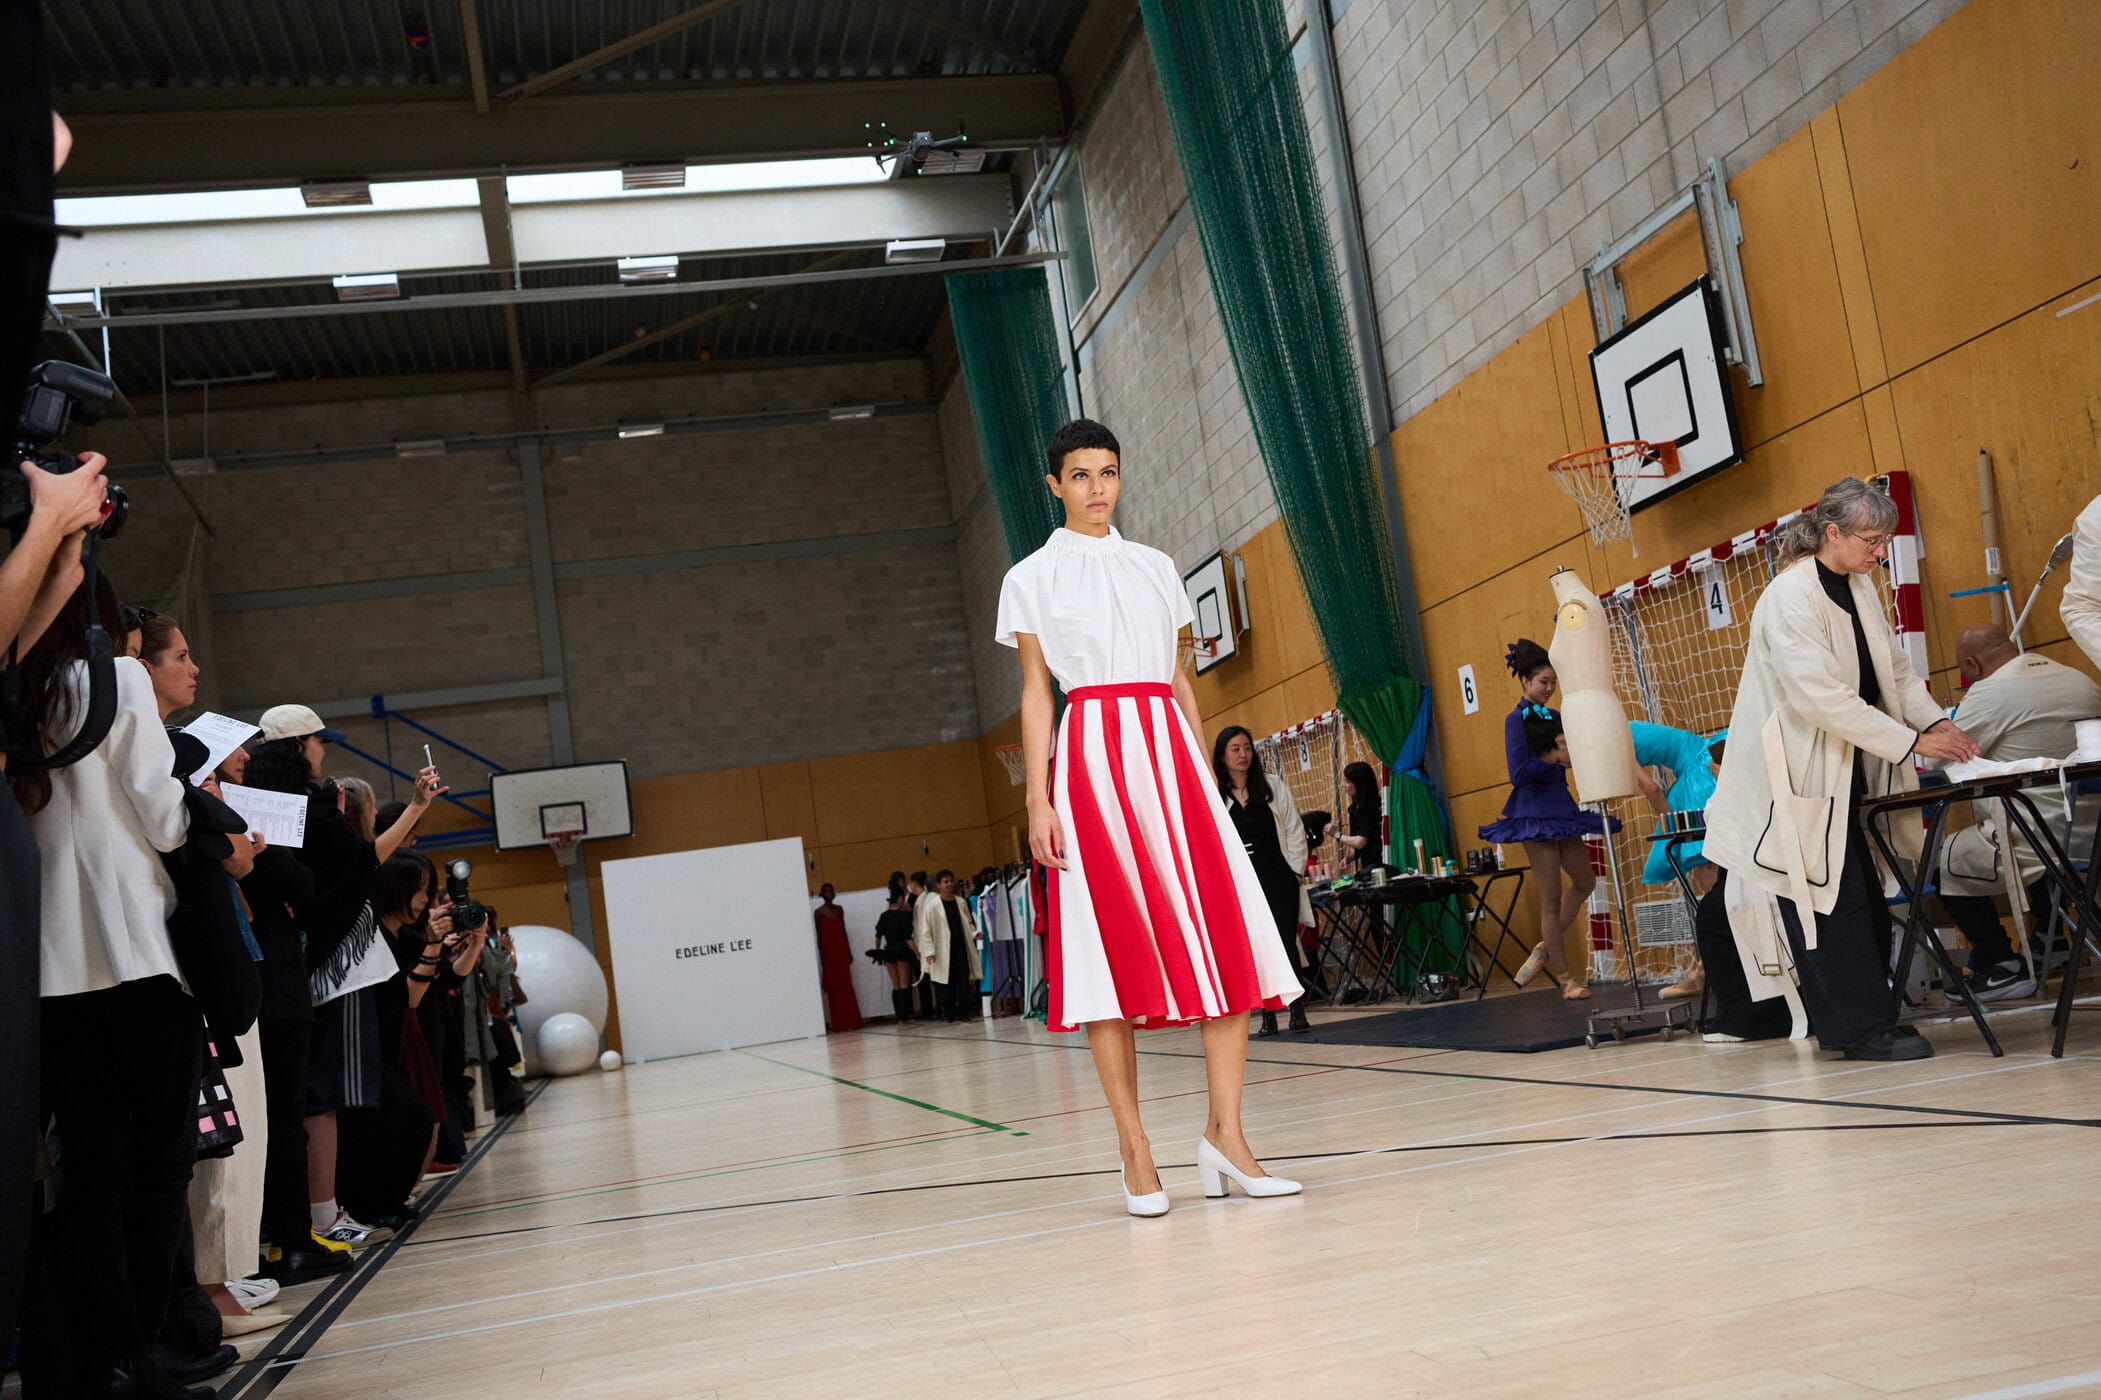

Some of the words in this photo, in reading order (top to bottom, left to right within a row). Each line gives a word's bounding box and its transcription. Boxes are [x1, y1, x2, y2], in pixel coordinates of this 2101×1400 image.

[1711, 582, 1723, 614] 4
[1464, 677, 1474, 704] 6
[675, 942, 725, 959] EDELINE
[730, 939, 753, 952] LEE
